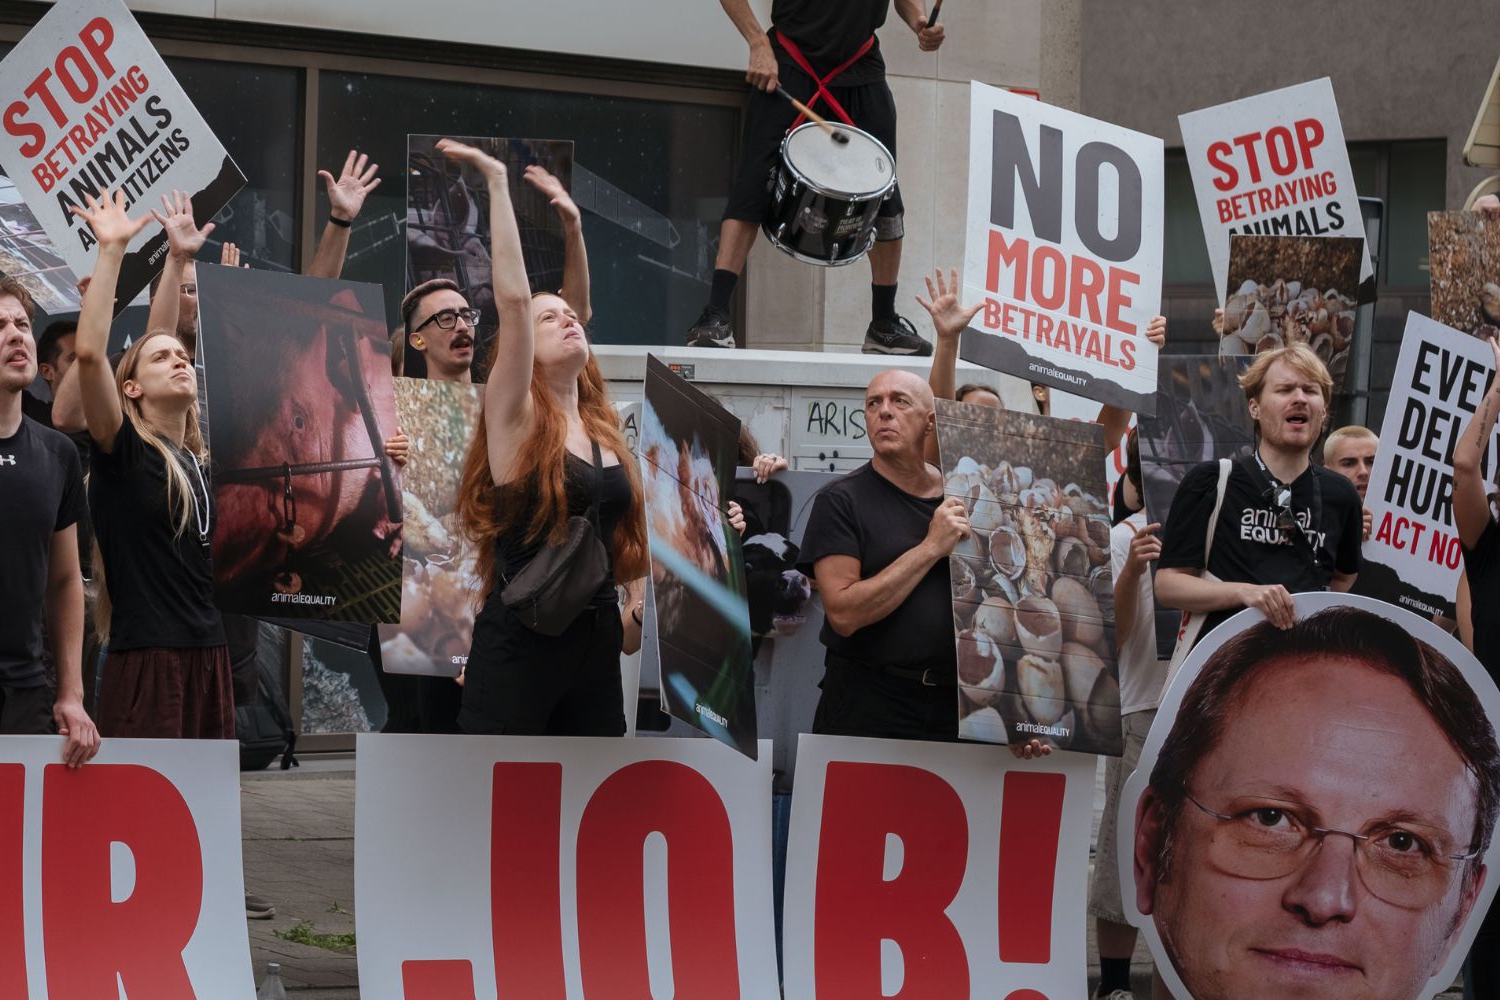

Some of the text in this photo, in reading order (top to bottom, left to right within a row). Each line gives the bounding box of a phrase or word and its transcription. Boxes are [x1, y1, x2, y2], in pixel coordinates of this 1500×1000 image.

[2, 16, 117, 159] STOP
[31, 65, 150, 194] BETRAYING
[56, 95, 173, 228] ANIMALS
[1206, 118, 1325, 192] STOP
[111, 127, 190, 213] CITIZENS
[990, 108, 1142, 262] NO
[1216, 171, 1338, 224] BETRAYING
[985, 229, 1141, 336] MORE
[983, 297, 1137, 371] BETRAYALS
[1028, 362, 1087, 386] animalEQUALITY
[1240, 506, 1312, 529] anial
[1375, 511, 1426, 556] ACT
[271, 590, 337, 606] animalEQUALITY
[1016, 720, 1070, 737] animalEQUALITY
